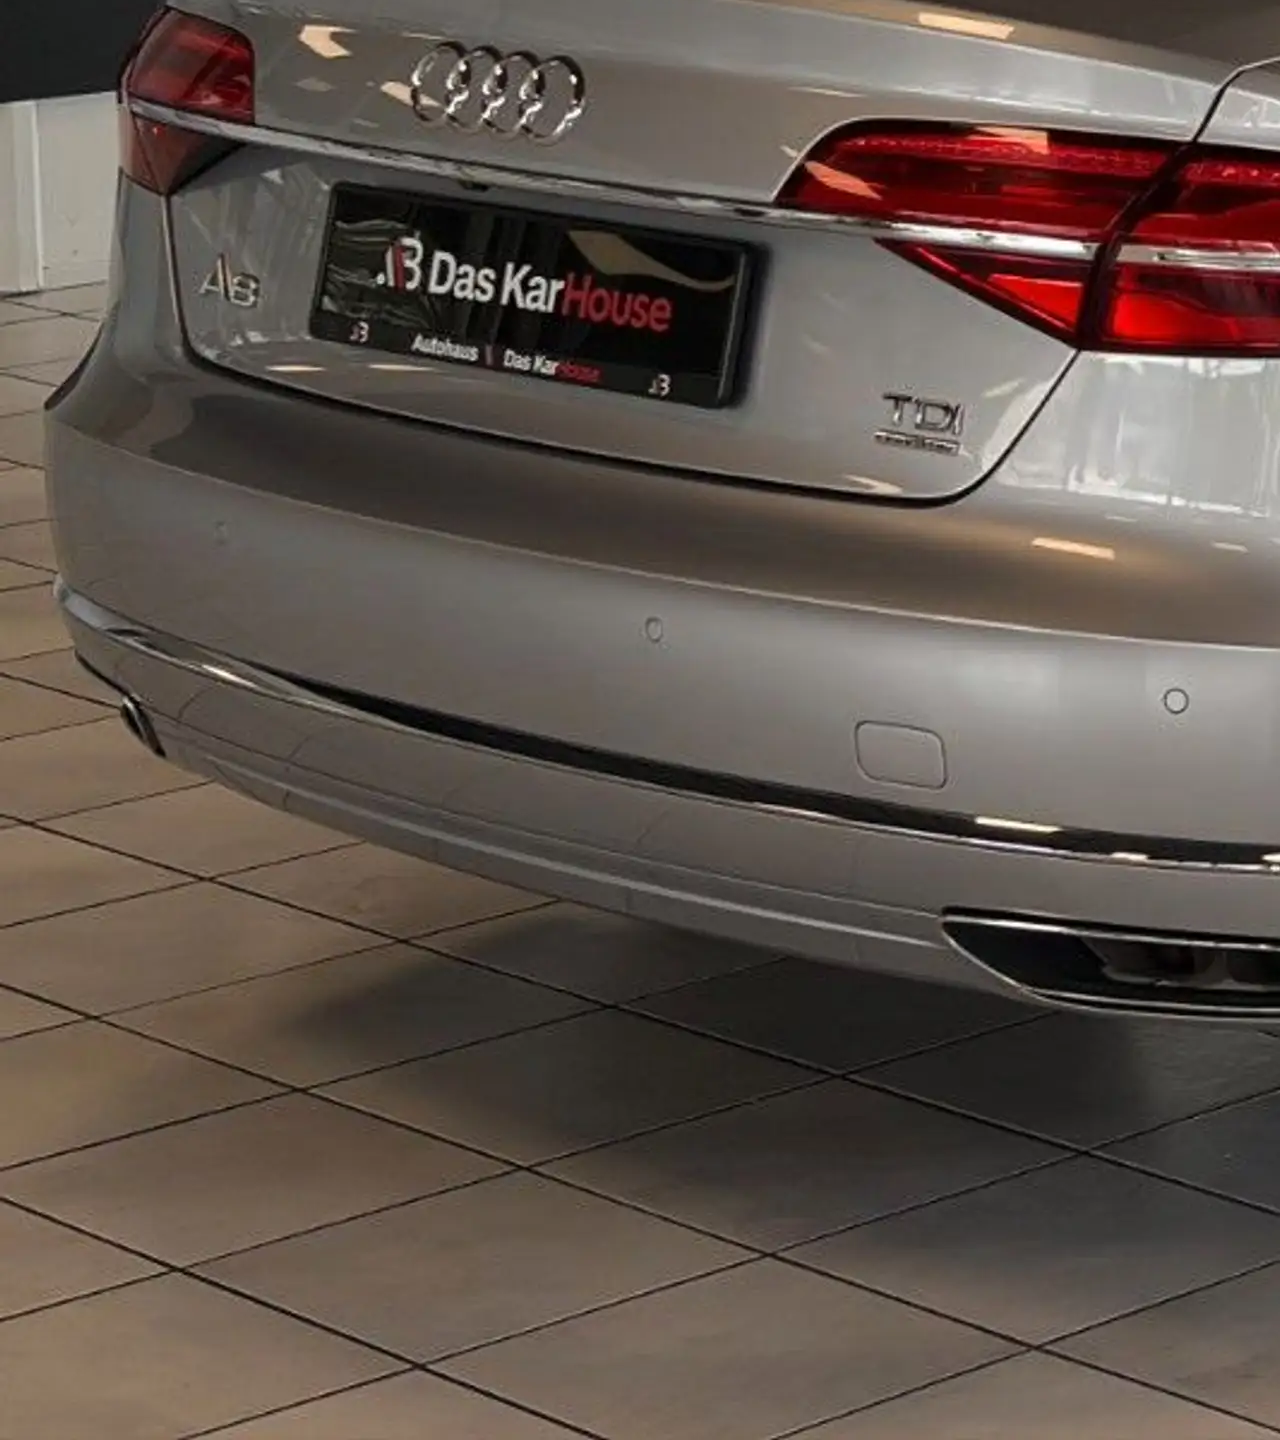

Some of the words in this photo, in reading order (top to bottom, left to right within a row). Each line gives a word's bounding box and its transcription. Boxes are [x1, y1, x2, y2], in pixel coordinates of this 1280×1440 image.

[428, 249, 498, 303] Das
[499, 262, 673, 333] KarHouse
[410, 332, 480, 362] Autohaus
[503, 348, 533, 372] Das
[882, 392, 965, 437] TDI
